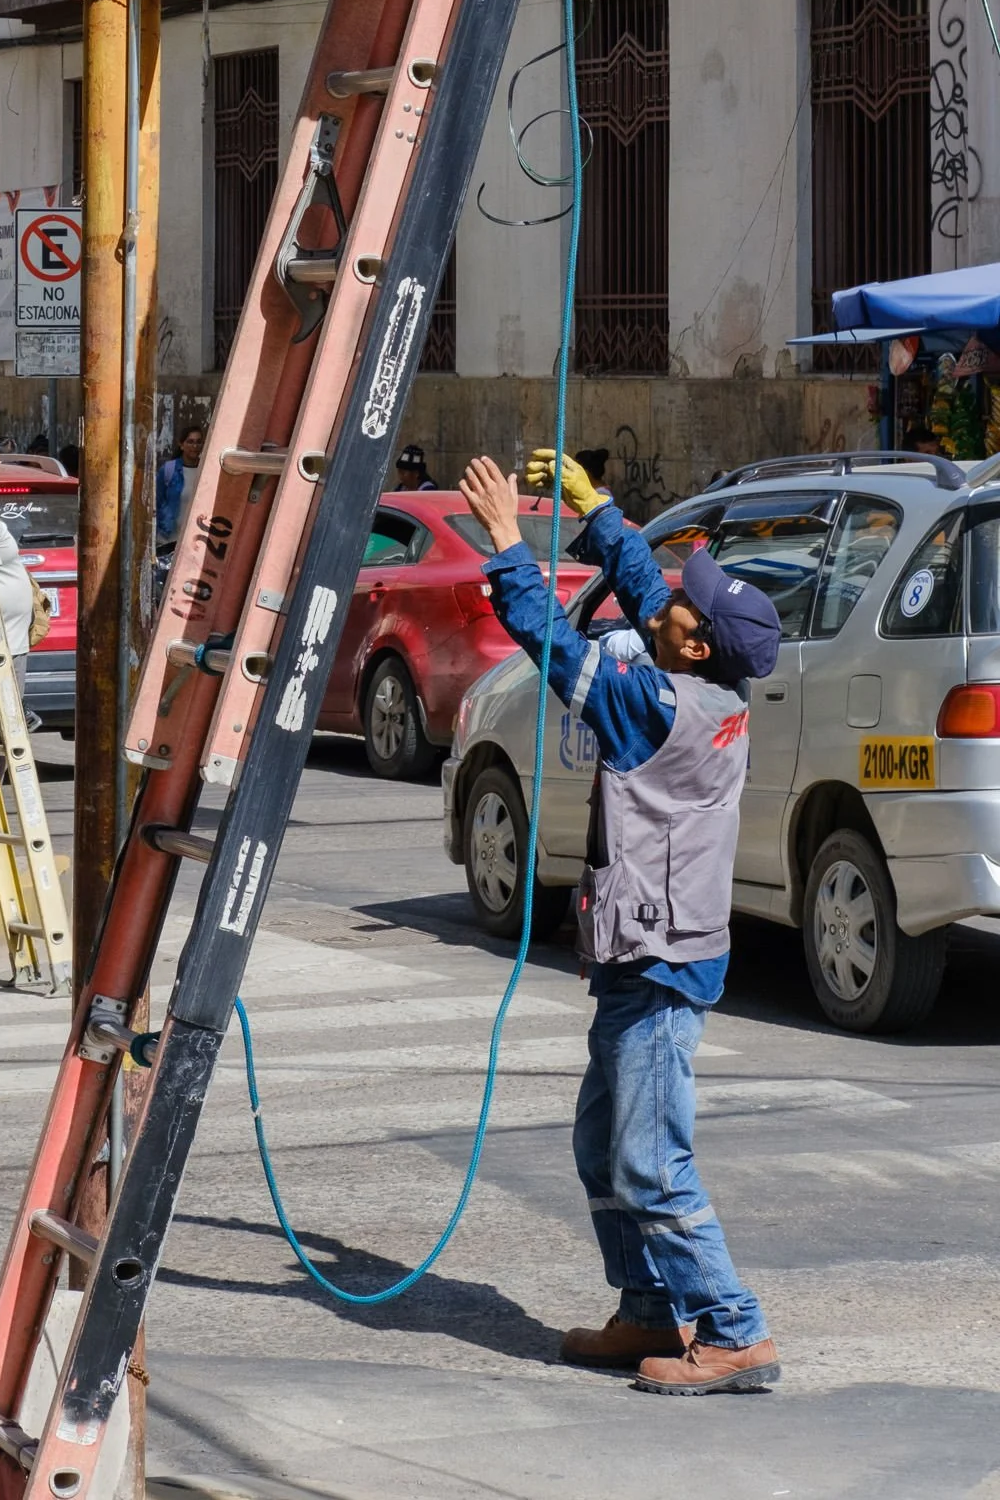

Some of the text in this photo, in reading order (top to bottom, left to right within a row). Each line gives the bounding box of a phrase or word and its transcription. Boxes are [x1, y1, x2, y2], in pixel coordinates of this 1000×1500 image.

[43, 286, 65, 301] NO
[18, 305, 80, 321] ESTACIONA
[909, 585, 923, 607] 8
[863, 743, 931, 781] 2100-KGR
